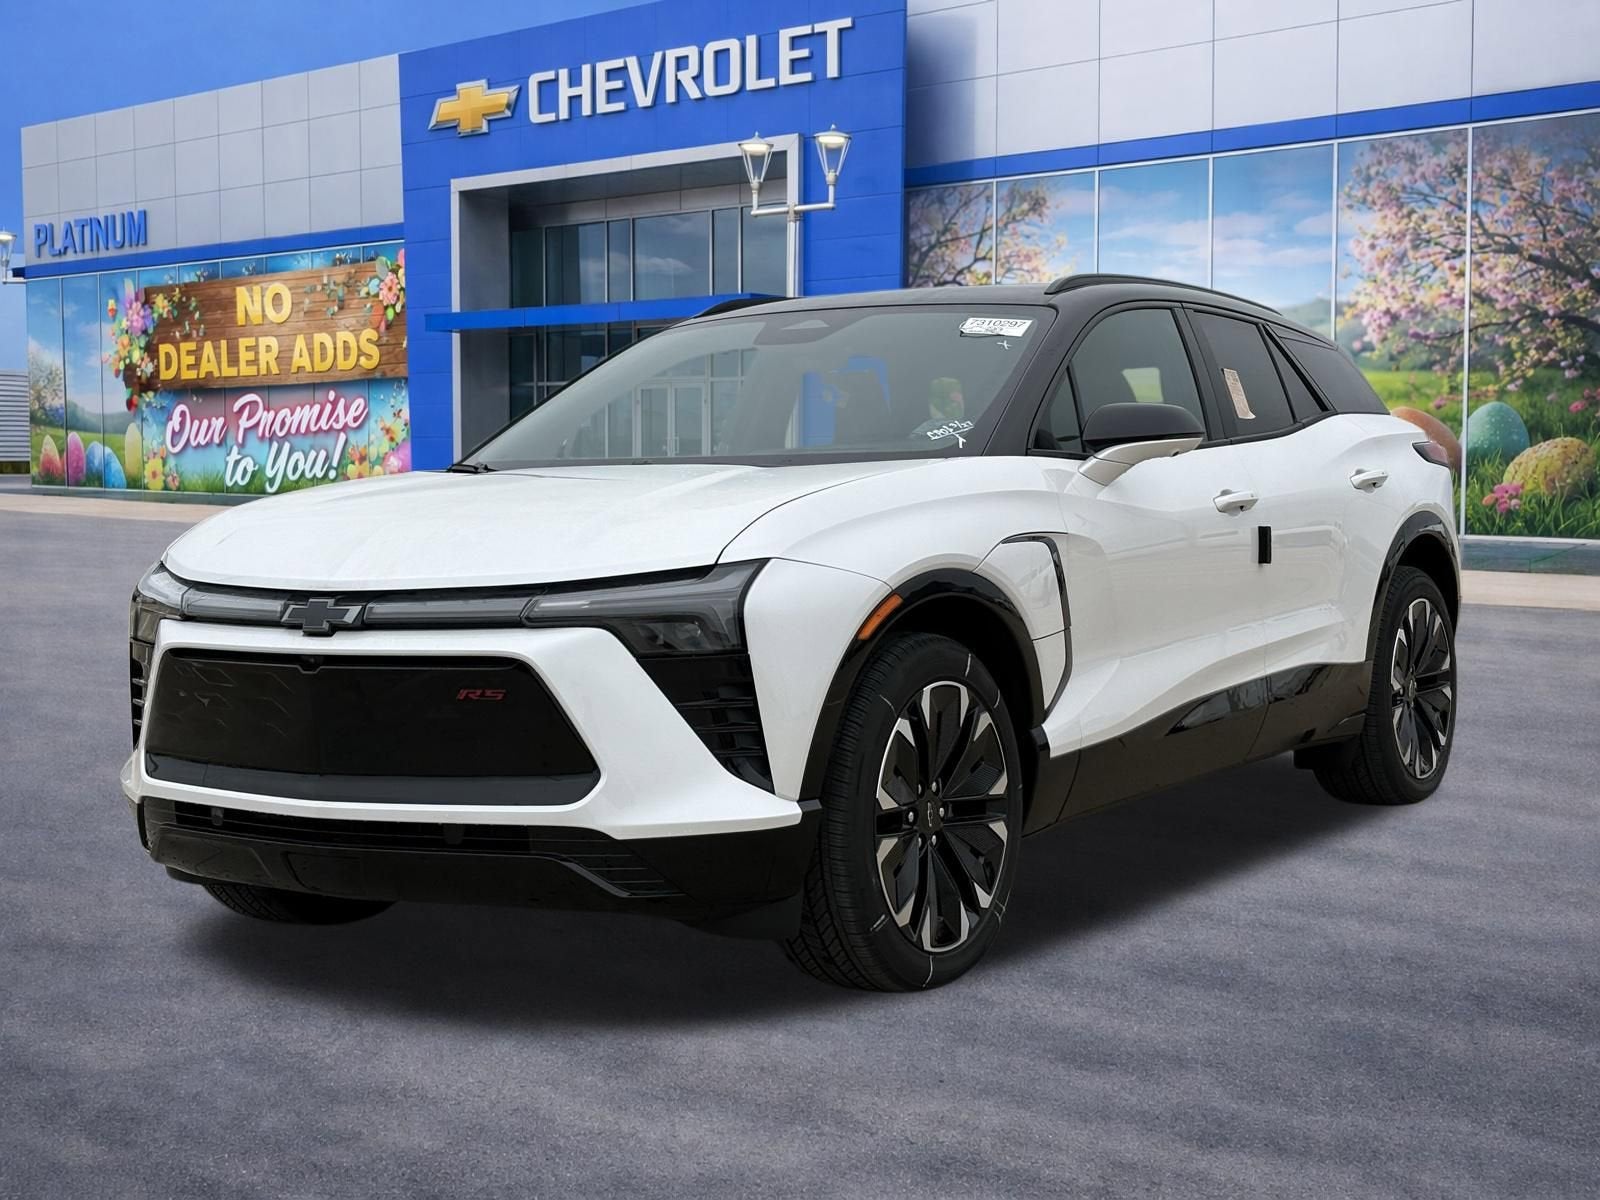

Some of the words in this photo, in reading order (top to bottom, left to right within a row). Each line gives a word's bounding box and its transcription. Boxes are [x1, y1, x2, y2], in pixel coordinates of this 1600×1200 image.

[528, 17, 853, 124] CHEVROLET
[34, 210, 147, 258] PLATINUM
[235, 283, 292, 326] NO
[158, 336, 280, 380] DEALER
[290, 330, 380, 374] ADDS
[166, 404, 228, 453] Our
[233, 391, 368, 440] Promise
[224, 444, 256, 485] to
[265, 432, 347, 493] You!
[456, 689, 506, 700] RS
